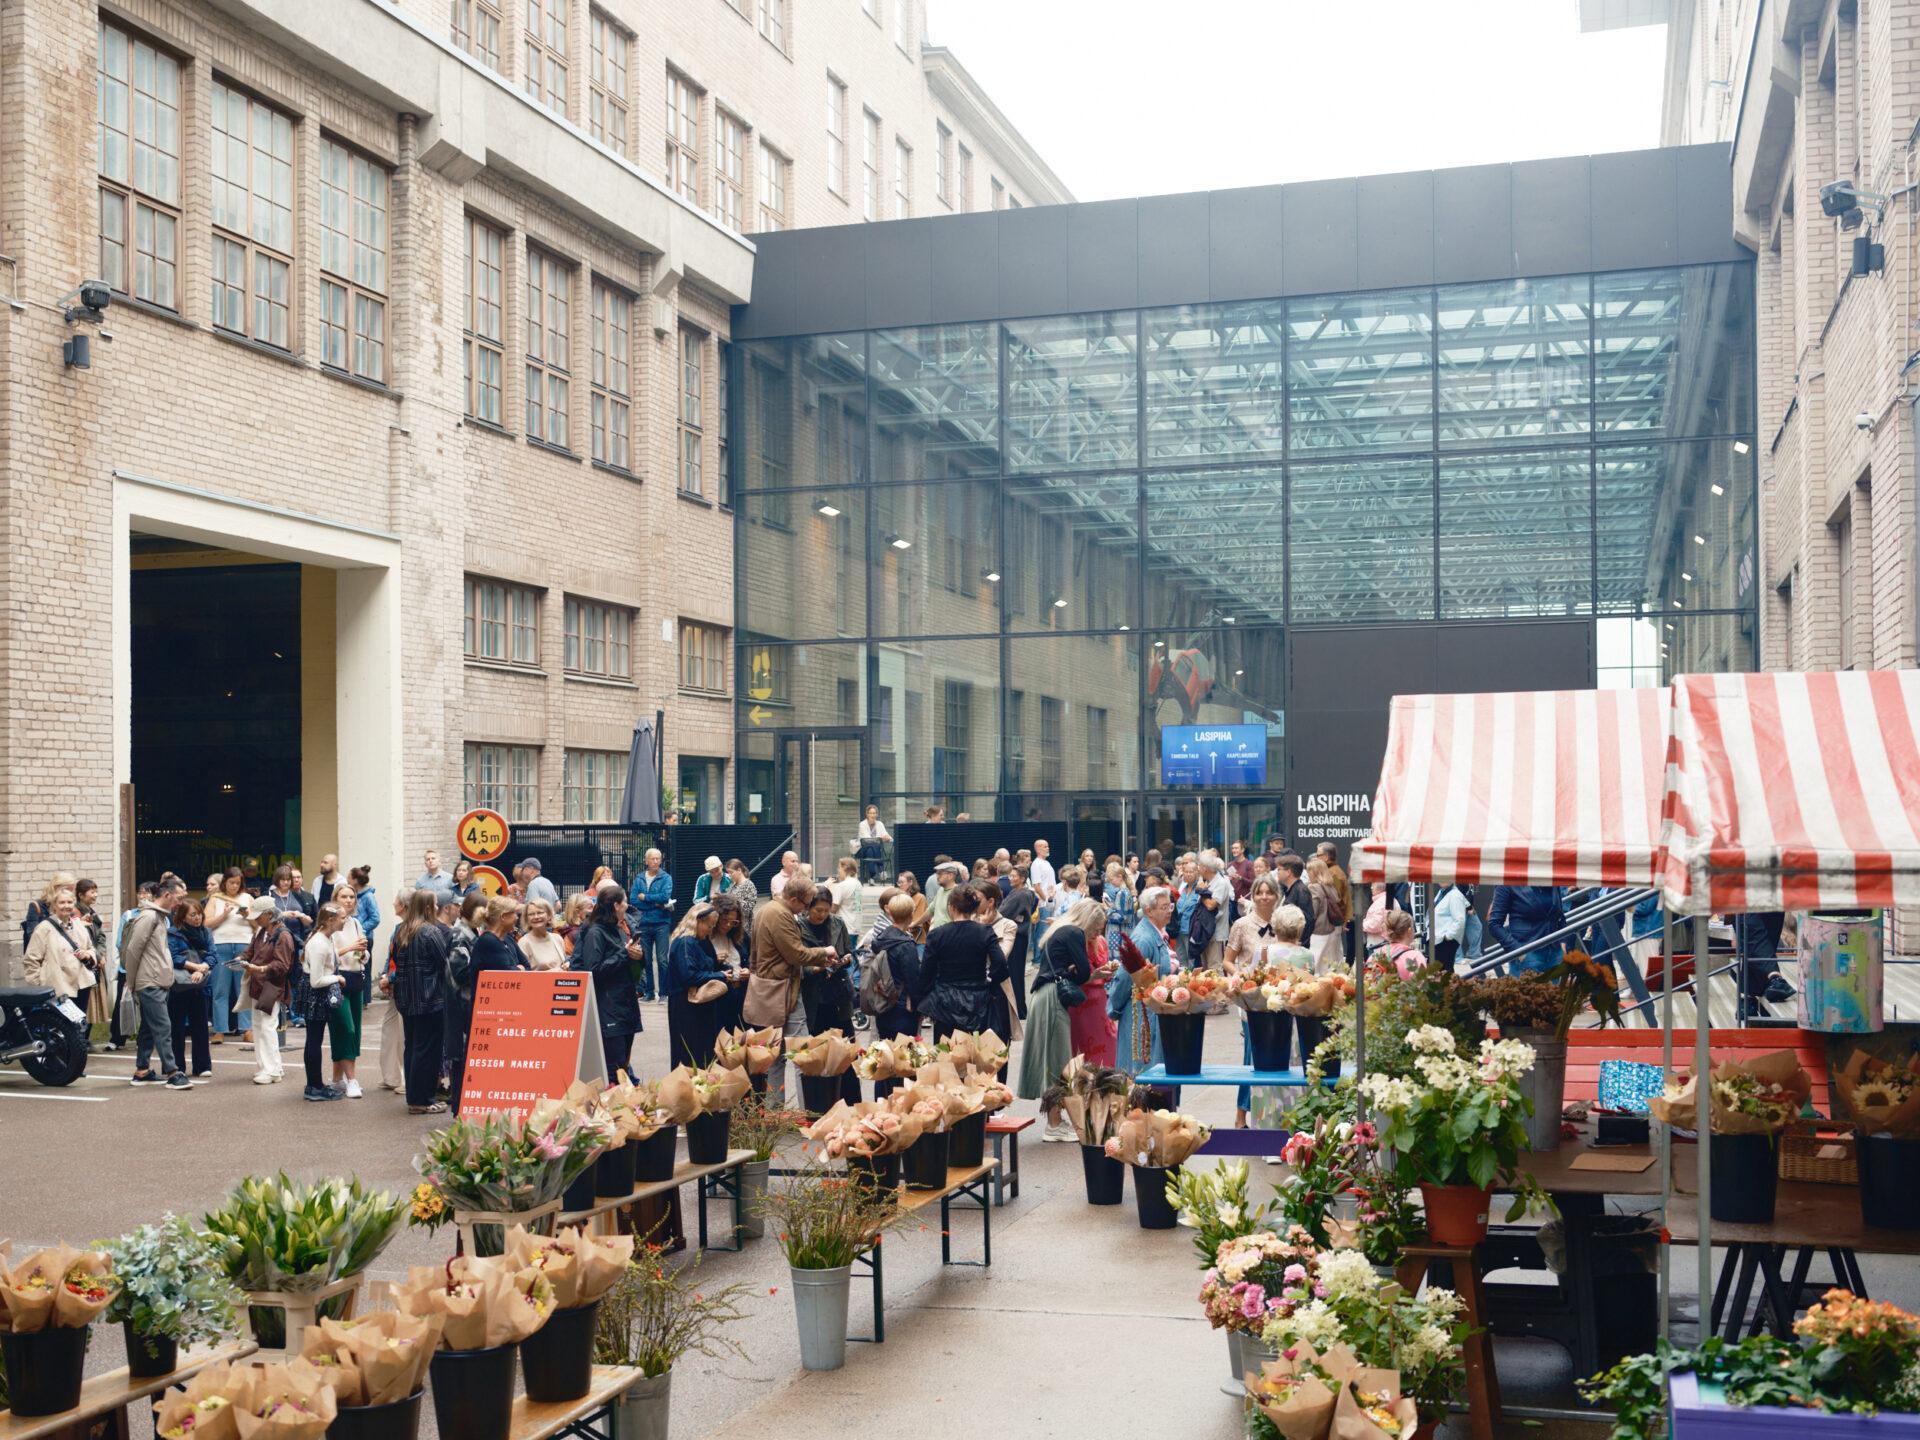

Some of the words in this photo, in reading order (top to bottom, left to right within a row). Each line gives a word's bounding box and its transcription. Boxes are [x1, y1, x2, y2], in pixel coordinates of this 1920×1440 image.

[1195, 731, 1232, 742] LASIPIHA
[1297, 794, 1370, 812] LASIPIHA
[1297, 814, 1351, 825] GLASGÅRDEN
[1297, 828, 1324, 838] GLASS
[480, 981, 522, 989] WELCOME
[475, 1028, 491, 1036] THE
[497, 1028, 526, 1037] CABLE
[533, 1029, 575, 1038] FACTORY
[472, 1043, 489, 1051] FOR
[469, 1059, 504, 1068] DESIGN
[511, 1060, 546, 1069] MARKET
[467, 1074, 472, 1082] &
[488, 1091, 548, 1101] CHILDREN'S
[462, 1106, 497, 1115] DESIGN
